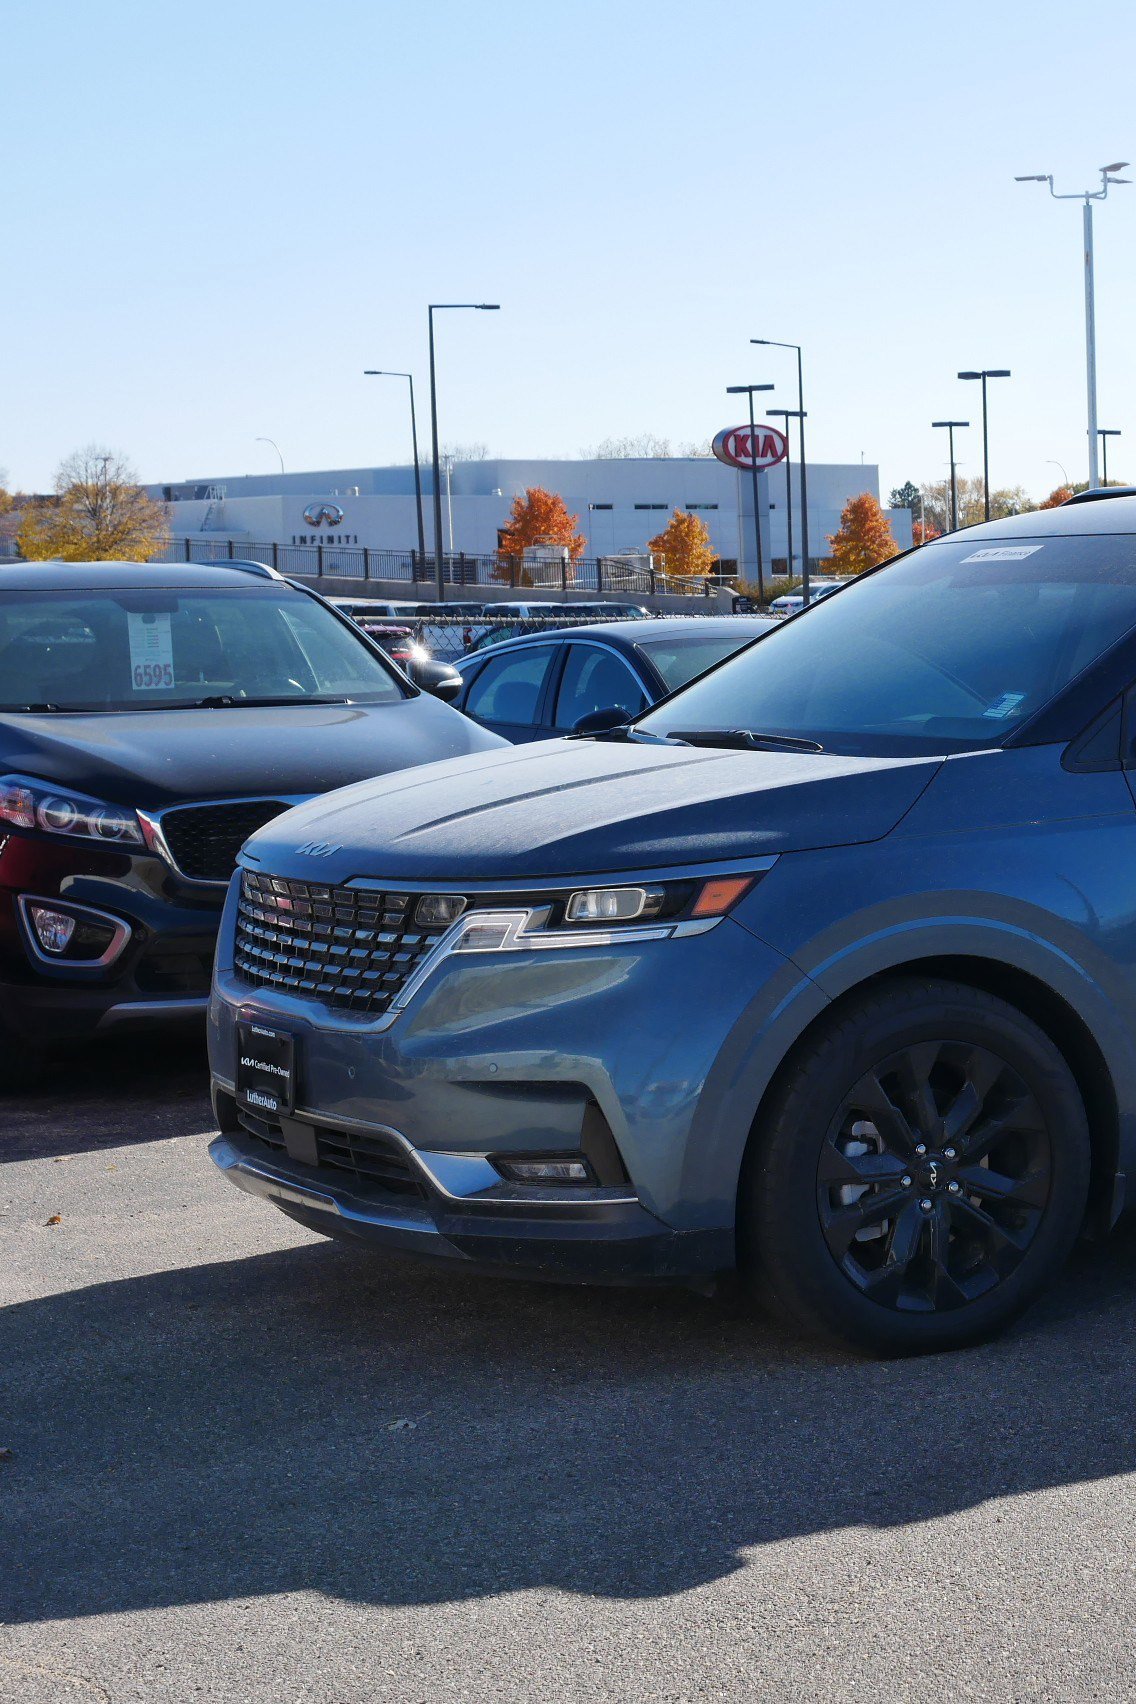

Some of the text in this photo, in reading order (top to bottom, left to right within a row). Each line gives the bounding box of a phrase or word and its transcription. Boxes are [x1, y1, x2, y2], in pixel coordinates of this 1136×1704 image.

[733, 434, 779, 458] KIA
[292, 535, 358, 545] INFINITI
[133, 663, 173, 688] 6595
[254, 1059, 271, 1073] Certified
[246, 1089, 278, 1111] LutherAuto
